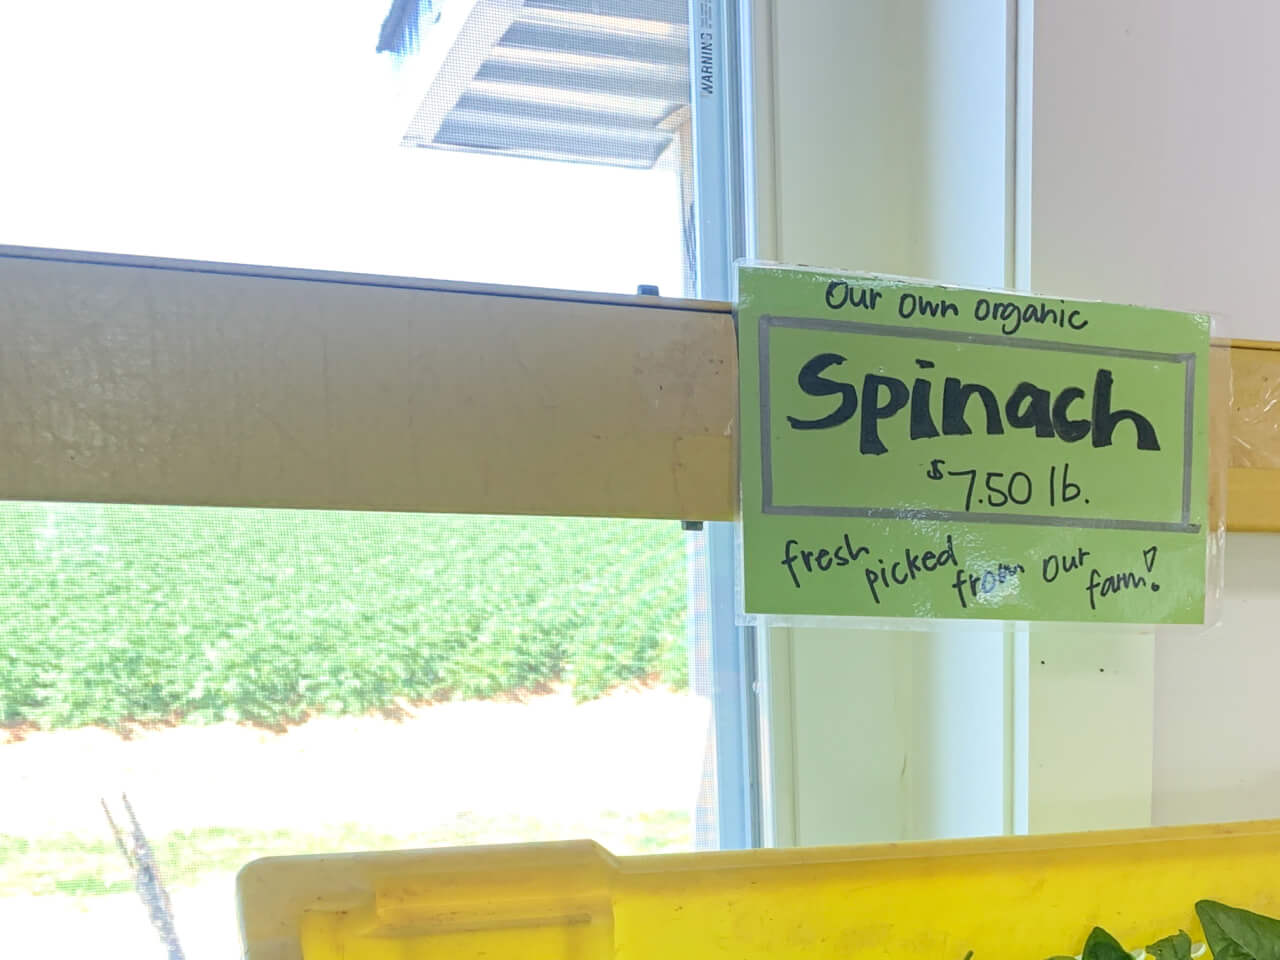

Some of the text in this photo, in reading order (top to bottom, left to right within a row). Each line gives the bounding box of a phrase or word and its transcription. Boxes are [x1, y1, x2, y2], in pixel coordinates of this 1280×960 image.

[700, 32, 713, 95] WARNING
[825, 280, 1089, 335] Our own organic
[787, 353, 1161, 455] Spinach
[926, 459, 1091, 511] $7.50 lb.
[781, 533, 1161, 610] fresh picked from our farm!
